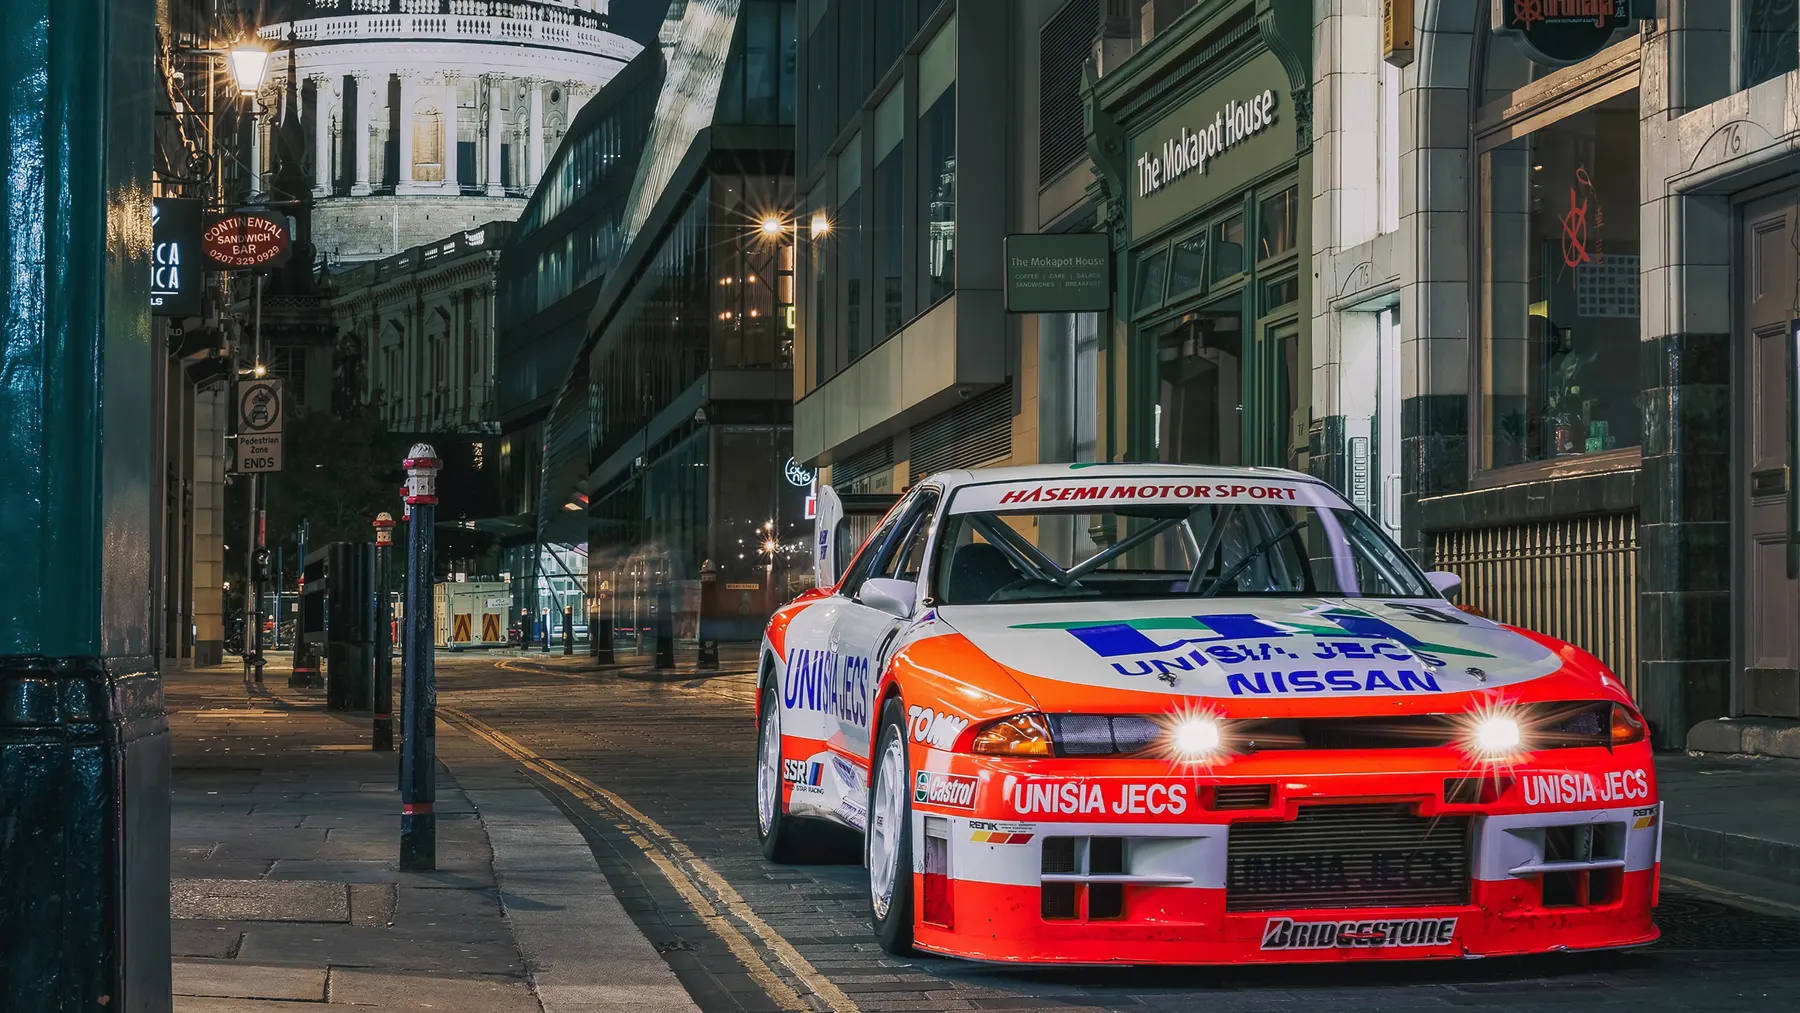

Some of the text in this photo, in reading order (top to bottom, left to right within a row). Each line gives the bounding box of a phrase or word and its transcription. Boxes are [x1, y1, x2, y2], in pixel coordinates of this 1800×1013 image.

[1137, 88, 1273, 197] The Mokapot House
[1722, 124, 1741, 157] 76
[204, 217, 283, 242] CONTINENTAL
[217, 233, 271, 245] SANDWICH
[209, 245, 280, 265] 0207 329 0929
[232, 244, 256, 255] BAR
[1011, 256, 1105, 268] The Mokapot House
[1065, 280, 1101, 288] BREAKFAST
[240, 436, 279, 446] Pedestrian
[250, 446, 268, 454] Zone
[244, 457, 275, 469] ENDS
[1000, 485, 1109, 504] HASEMI
[1215, 484, 1297, 500] SPORT
[784, 647, 838, 717] UNISIA
[839, 650, 869, 727] JECS
[1226, 670, 1443, 696] NISSAN
[783, 758, 807, 785] SSR
[929, 775, 977, 806] Castrol
[1014, 783, 1188, 815] UNISIA JECS
[1522, 768, 1649, 806] UNISIA JECS
[1260, 917, 1459, 950] BRIDGESTONE
